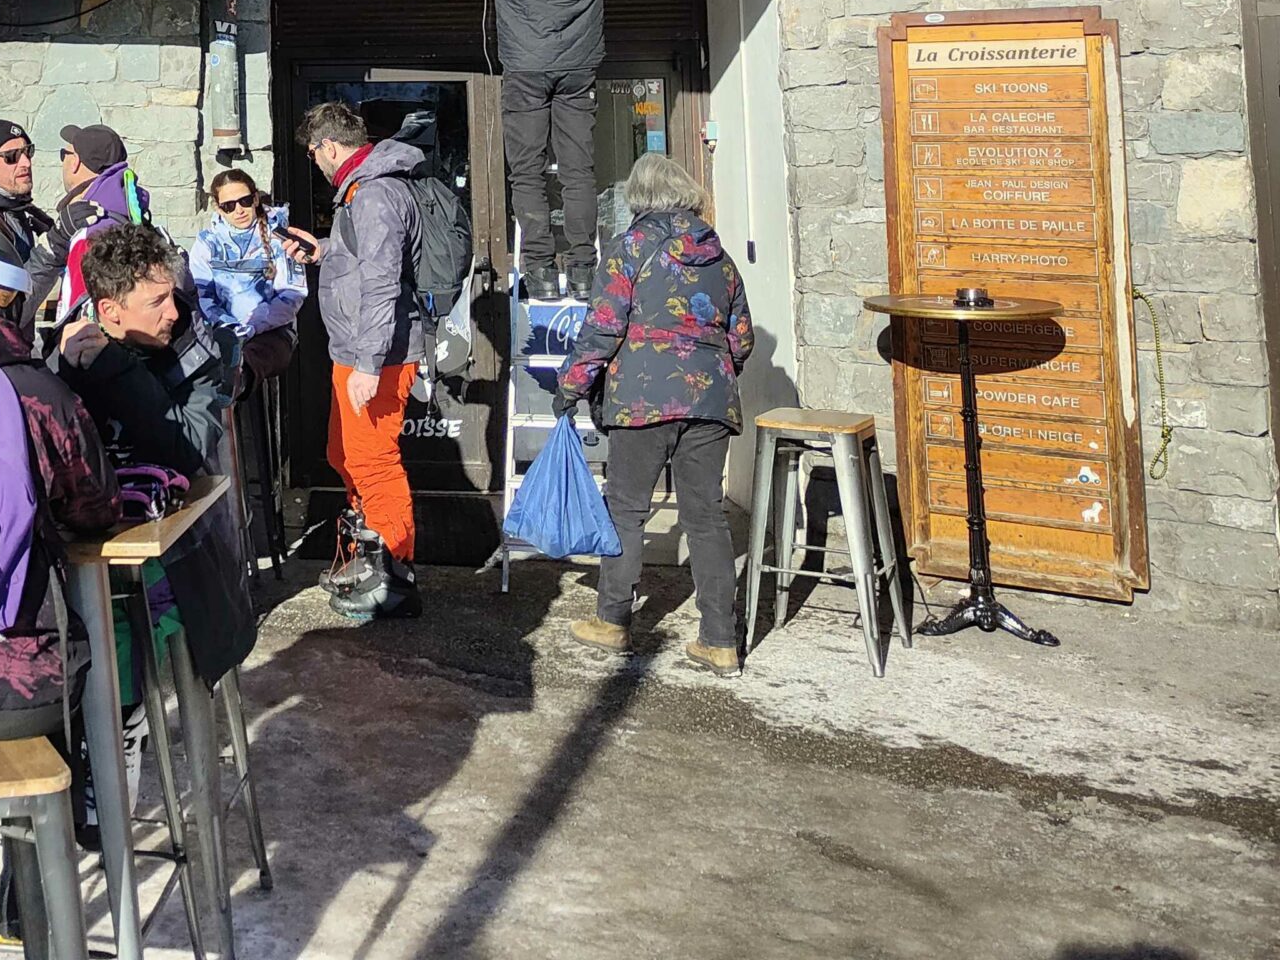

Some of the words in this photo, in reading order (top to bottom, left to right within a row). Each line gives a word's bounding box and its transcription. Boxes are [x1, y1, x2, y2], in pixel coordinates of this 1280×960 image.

[916, 48, 937, 62] La
[948, 44, 1077, 61] Croissanterie
[975, 83, 996, 94] SKI
[1001, 83, 1048, 93] TOONS
[970, 113, 988, 122] LA
[992, 112, 1055, 123] CALECHE
[964, 125, 984, 134] BAR
[968, 148, 1048, 158] EVOLUTION
[1054, 147, 1062, 157] 2
[965, 179, 991, 188] JEAN
[1002, 180, 1027, 189] PAUL
[1030, 180, 1068, 189] DESIGN
[983, 191, 1050, 202] COIFFURE
[952, 218, 969, 229] LA
[973, 218, 1015, 230] BOTTE
[1020, 219, 1037, 230] DE
[1042, 220, 1085, 232] PAILLE
[973, 321, 1074, 337] CONCIERGERIE
[970, 354, 1080, 372] SUPERMARCHE
[1042, 396, 1080, 408] CAFE
[400, 418, 463, 438] OISSE
[1037, 428, 1082, 444] NEIGE
